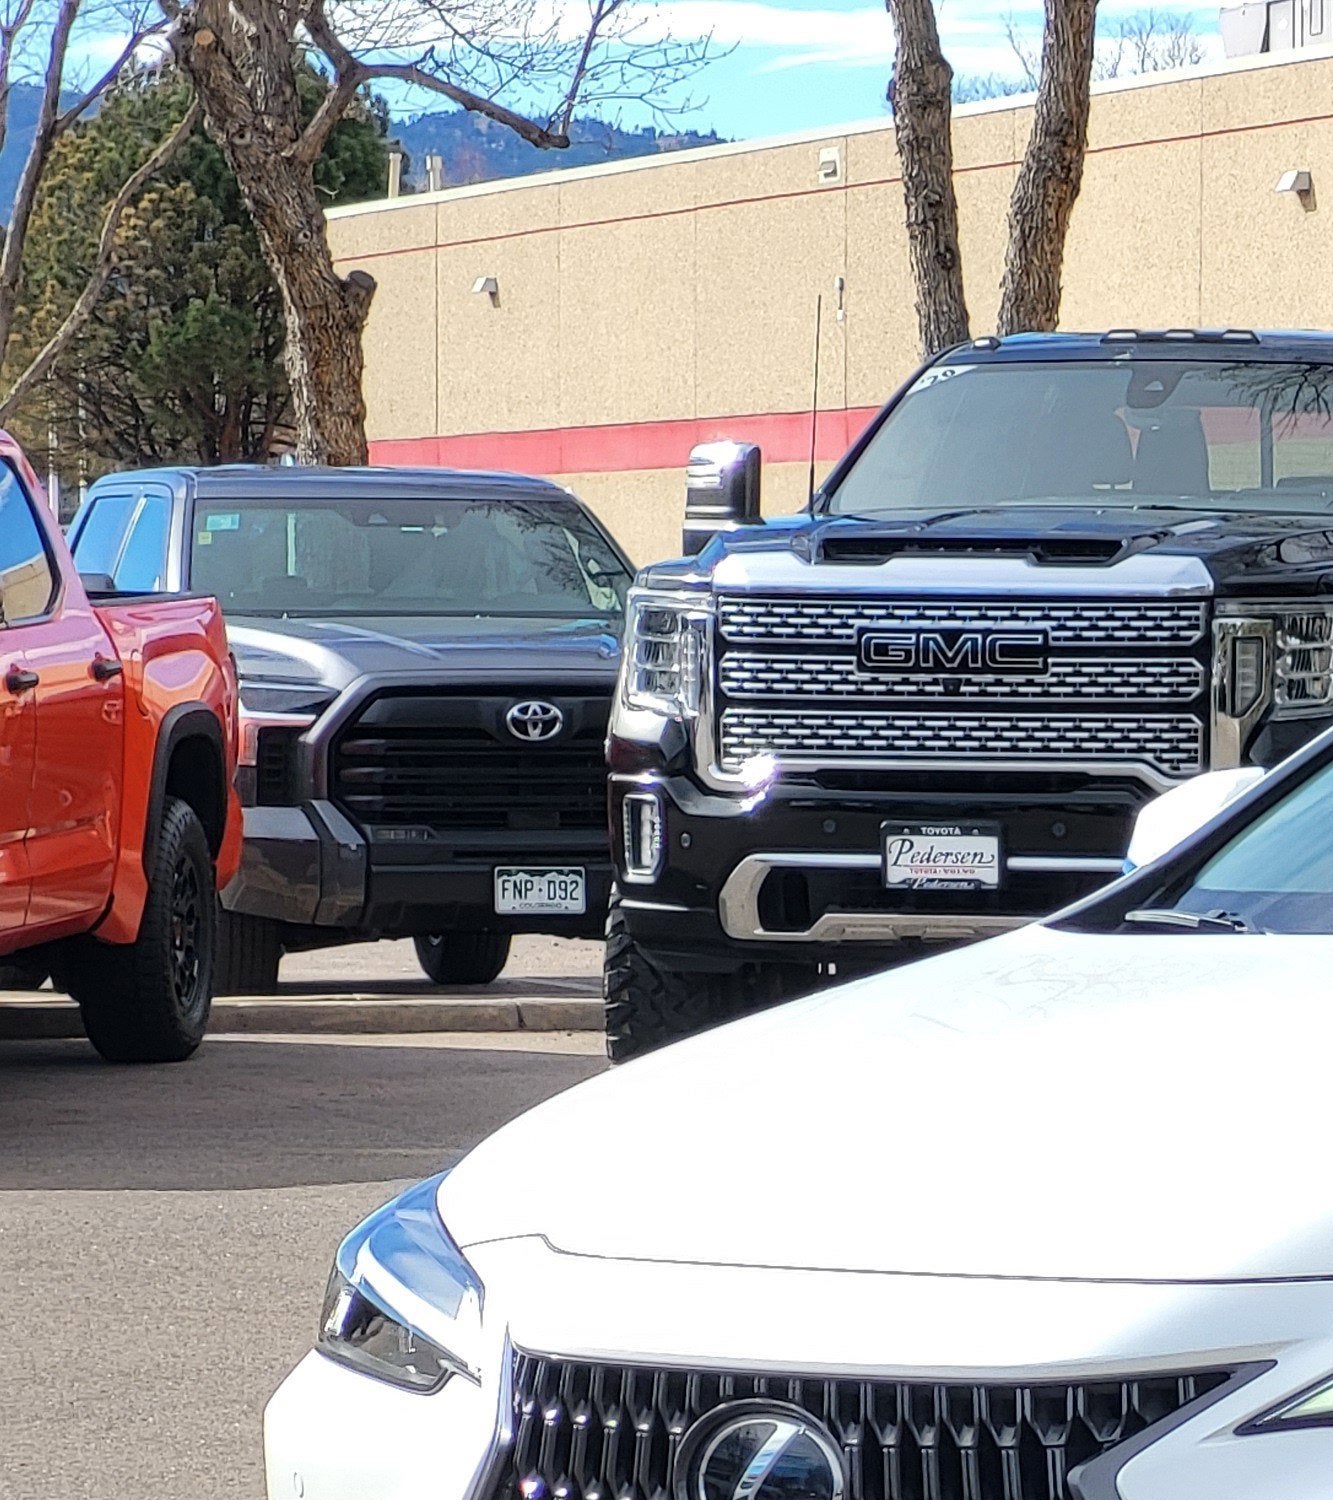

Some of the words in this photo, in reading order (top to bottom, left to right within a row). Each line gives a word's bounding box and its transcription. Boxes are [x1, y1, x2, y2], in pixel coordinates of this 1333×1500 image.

[861, 633, 1043, 668] GMC
[920, 827, 962, 836] TOYOTA
[889, 838, 995, 867] Pedersen
[501, 878, 534, 900] FNP
[547, 880, 579, 901] D92
